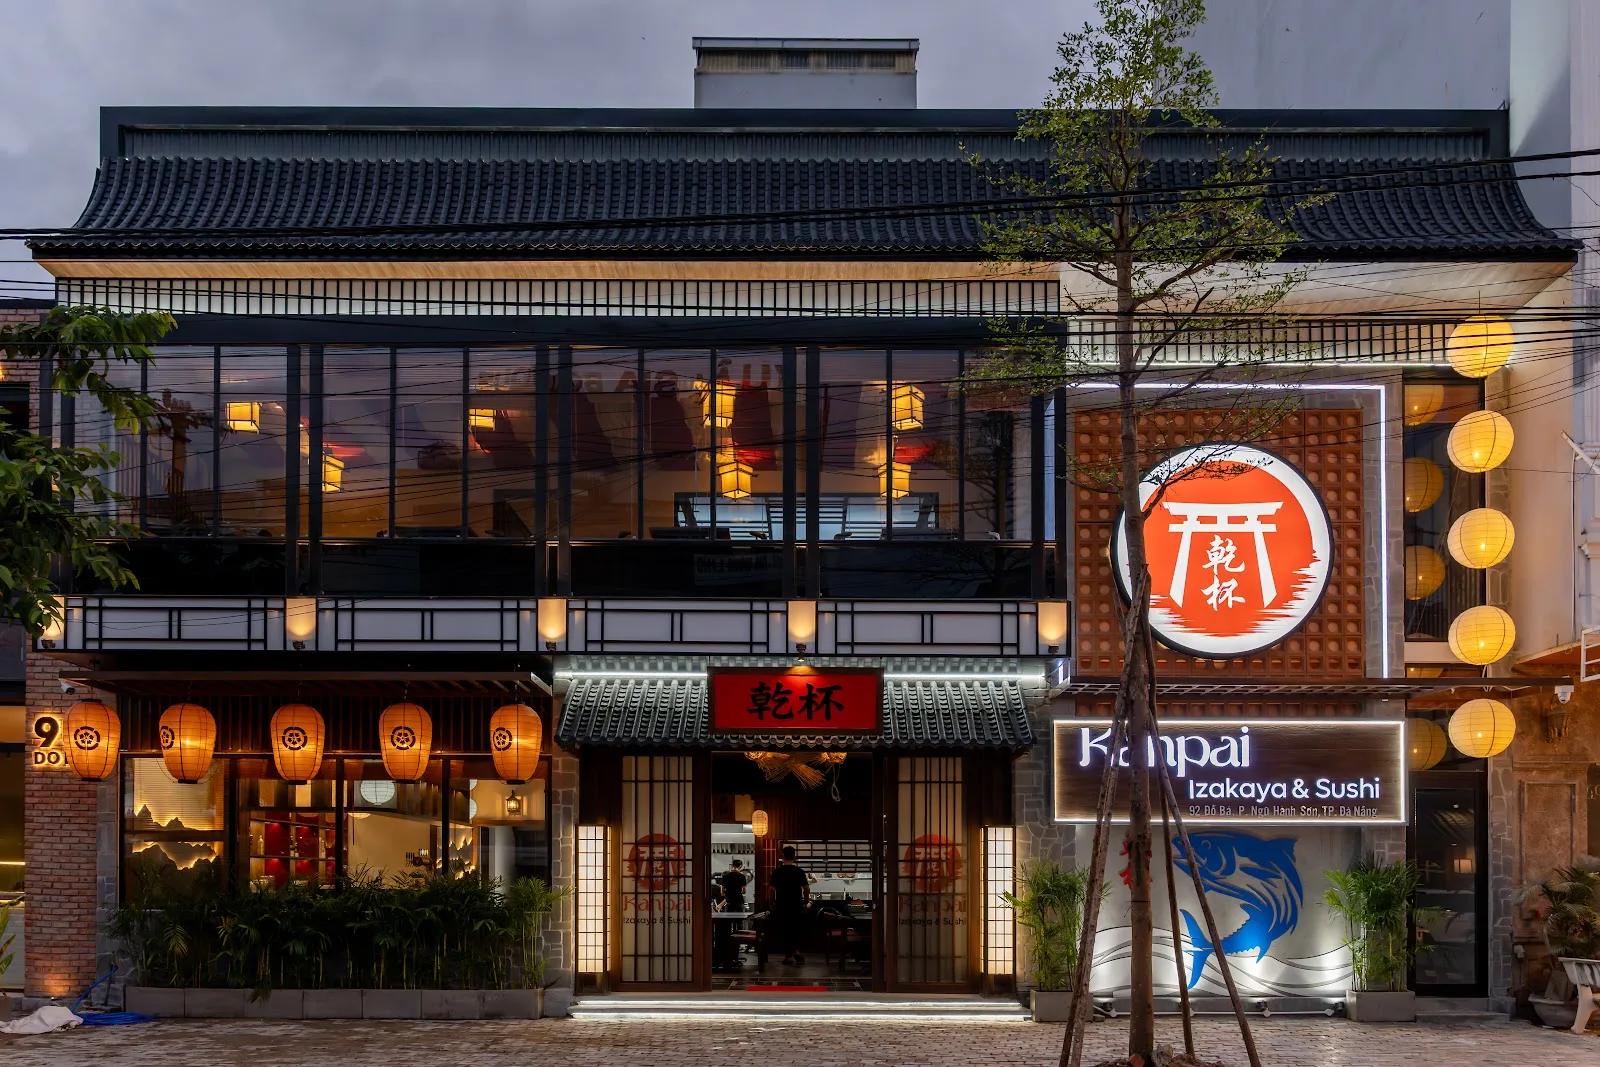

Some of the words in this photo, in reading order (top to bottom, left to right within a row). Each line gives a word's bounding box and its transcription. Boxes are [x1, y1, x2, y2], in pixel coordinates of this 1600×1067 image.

[1201, 534, 1246, 612] 乾杯
[747, 681, 845, 720] 乾杯
[34, 751, 60, 764] DO
[1189, 778, 1288, 803] Izakaya
[1291, 779, 1310, 799] &
[1315, 777, 1380, 799] Sushi
[1189, 805, 1201, 816] 92
[1238, 805, 1248, 816] P.
[1273, 805, 1296, 816] Hành
